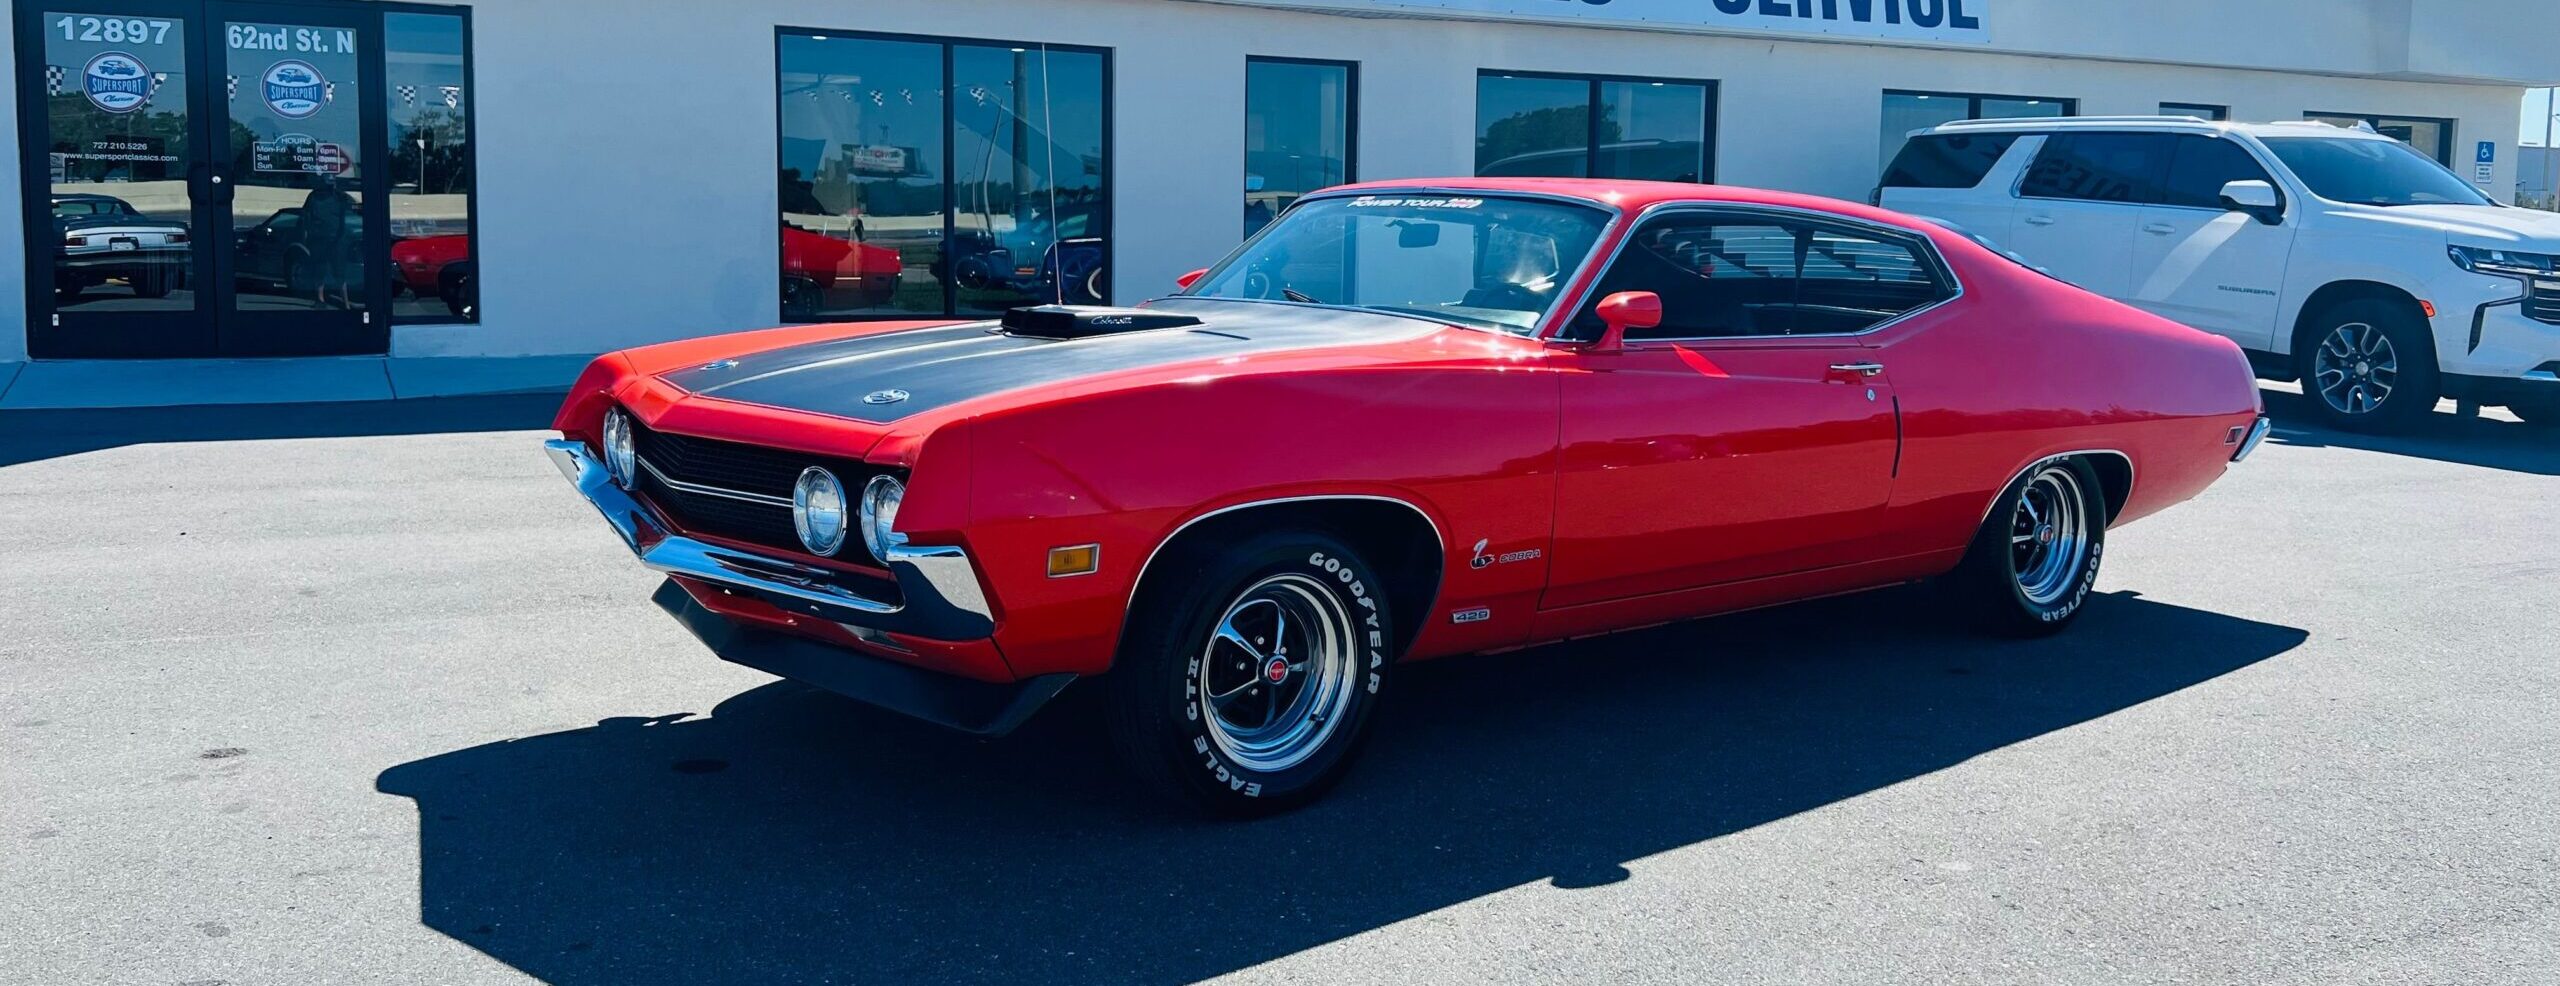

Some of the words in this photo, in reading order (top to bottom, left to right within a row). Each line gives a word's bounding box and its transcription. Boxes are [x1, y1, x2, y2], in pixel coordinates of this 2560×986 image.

[57, 16, 171, 44] 12897
[228, 25, 288, 50] 62nd
[296, 29, 329, 52] St.
[336, 31, 354, 53] N
[92, 77, 142, 93] SUPERSPORT
[271, 86, 317, 101] SUPERSPORT
[92, 142, 148, 151] 727.210.5226
[64, 153, 179, 162] www.supersportclassics.com
[301, 163, 328, 171] Closed
[1403, 199, 1445, 208] TOUR
[2217, 285, 2276, 296] SUBURBAN
[1499, 549, 1541, 563] COBRA
[2041, 542, 2101, 622] GOODYEAR
[1454, 610, 1489, 622] 429
[1309, 552, 1382, 695] GOODYEAR
[1193, 735, 1262, 798] EAGLE
